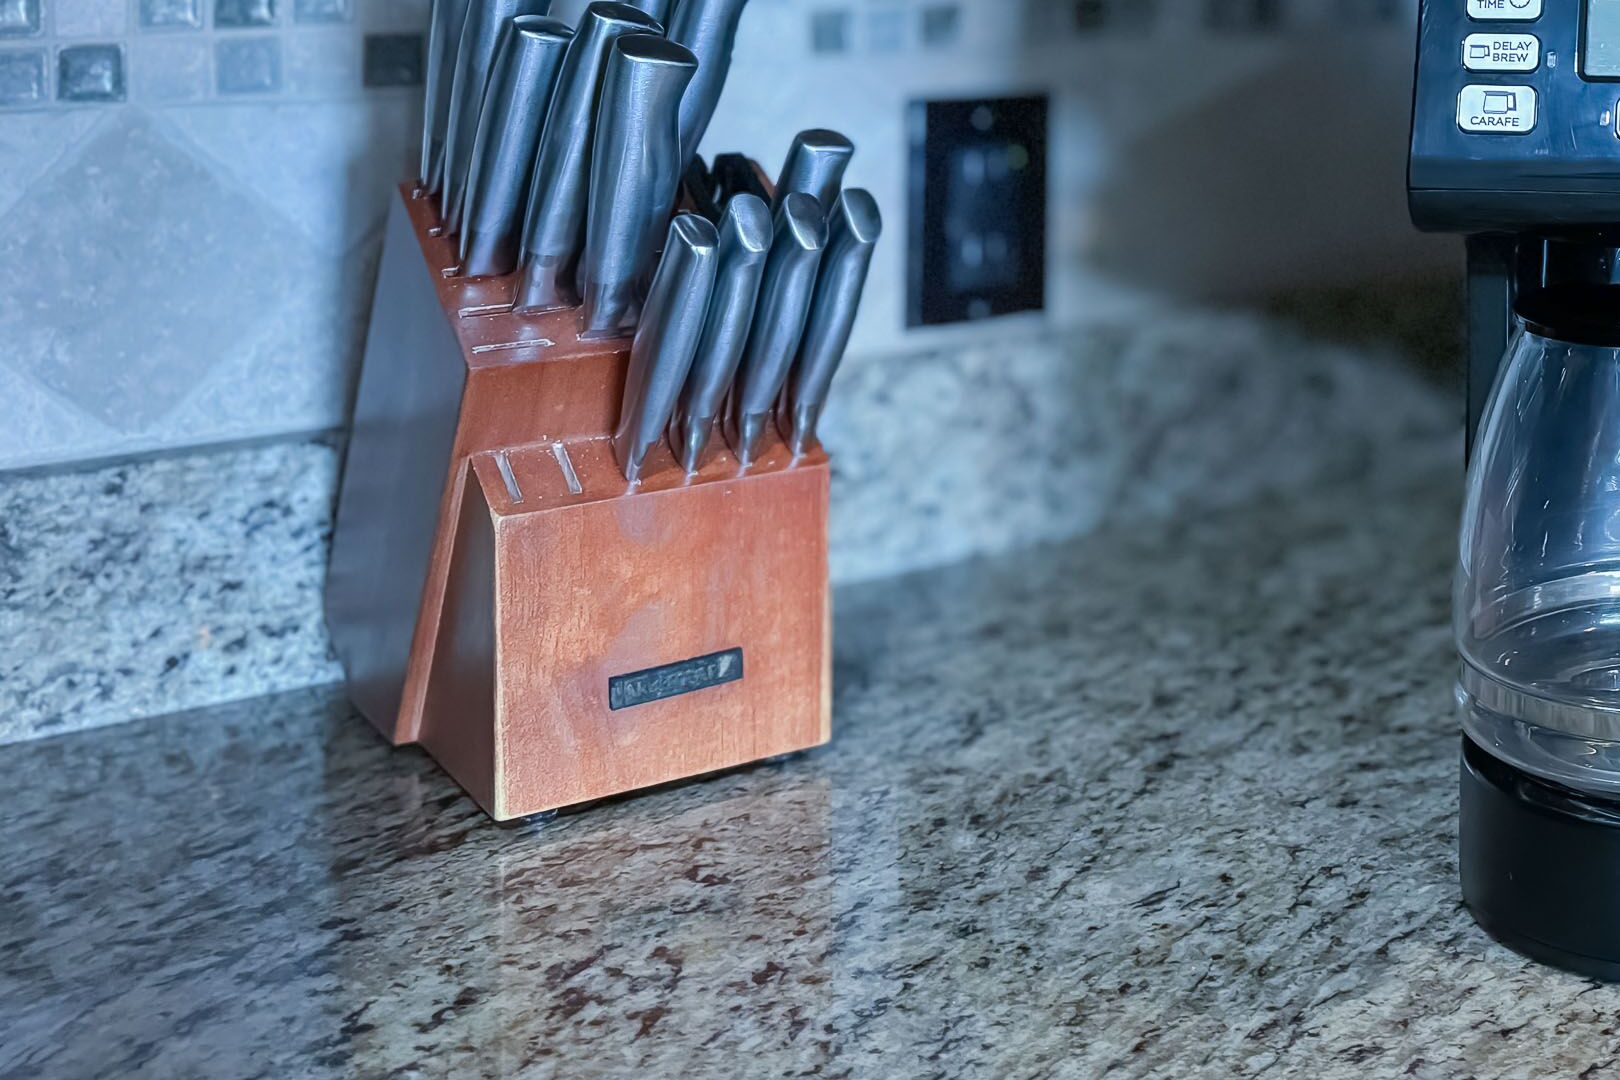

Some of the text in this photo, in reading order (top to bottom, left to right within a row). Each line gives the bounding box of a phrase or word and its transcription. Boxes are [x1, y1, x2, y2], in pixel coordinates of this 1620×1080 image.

[1477, 0, 1505, 9] TIME
[1493, 41, 1532, 51] DELAY
[1492, 53, 1529, 63] BREW
[1470, 115, 1520, 127] CARAFE
